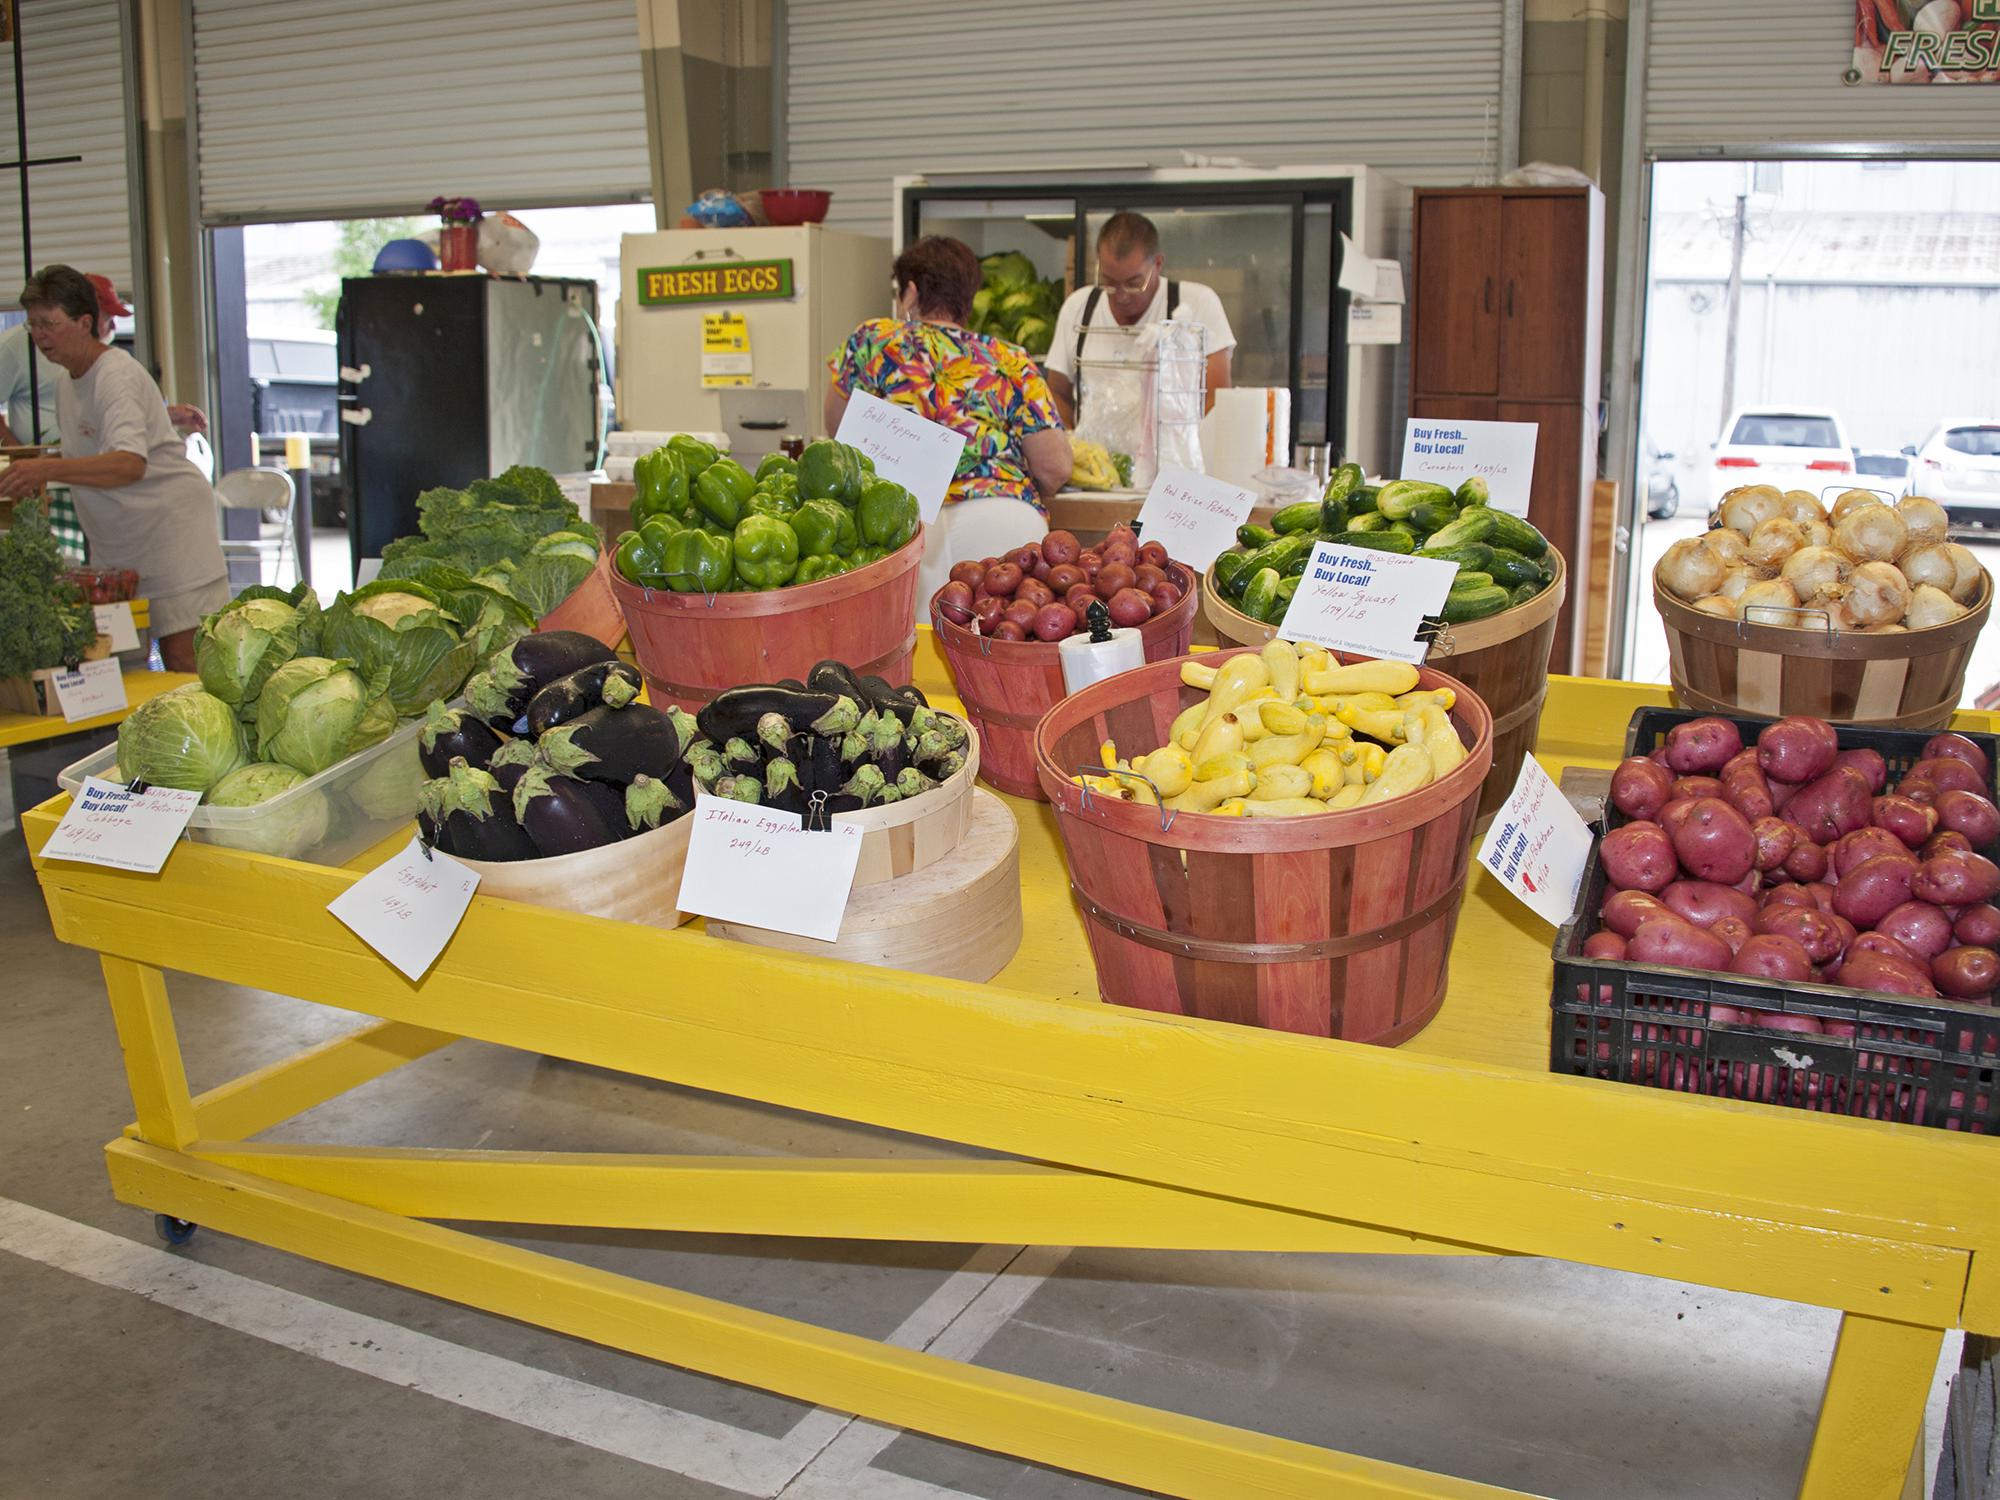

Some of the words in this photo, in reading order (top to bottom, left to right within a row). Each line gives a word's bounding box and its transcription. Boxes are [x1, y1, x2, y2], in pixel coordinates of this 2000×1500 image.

[647, 270, 718, 298] FRESH
[724, 266, 778, 294] EGGS
[863, 406, 886, 425] Bell
[938, 431, 949, 443] FL
[1413, 427, 1433, 439] Buy
[1434, 429, 1468, 440] Fresh...
[1414, 442, 1433, 454] Buy
[1435, 444, 1464, 455] Local!
[1163, 484, 1178, 496] Red
[1206, 500, 1238, 522] Potatoes
[1235, 492, 1246, 501] FL
[1317, 551, 1337, 566] Buy
[1339, 556, 1377, 572] Fresh...
[1313, 568, 1335, 582] Buy
[1336, 571, 1371, 587] Local!
[1312, 584, 1348, 598] Yellow
[1351, 589, 1399, 607] Squash
[86, 786, 104, 800] Buy
[81, 800, 99, 812] Buy
[100, 802, 128, 813] Local!
[86, 813, 133, 827] Cabbage
[843, 826, 856, 835] FL
[1489, 848, 1503, 870] Buy
[1496, 822, 1519, 853] Fresh...
[1509, 832, 1529, 866] Local!
[398, 865, 438, 894] Eggplant
[1503, 861, 1517, 883] Buy
[461, 879, 471, 892] FL
